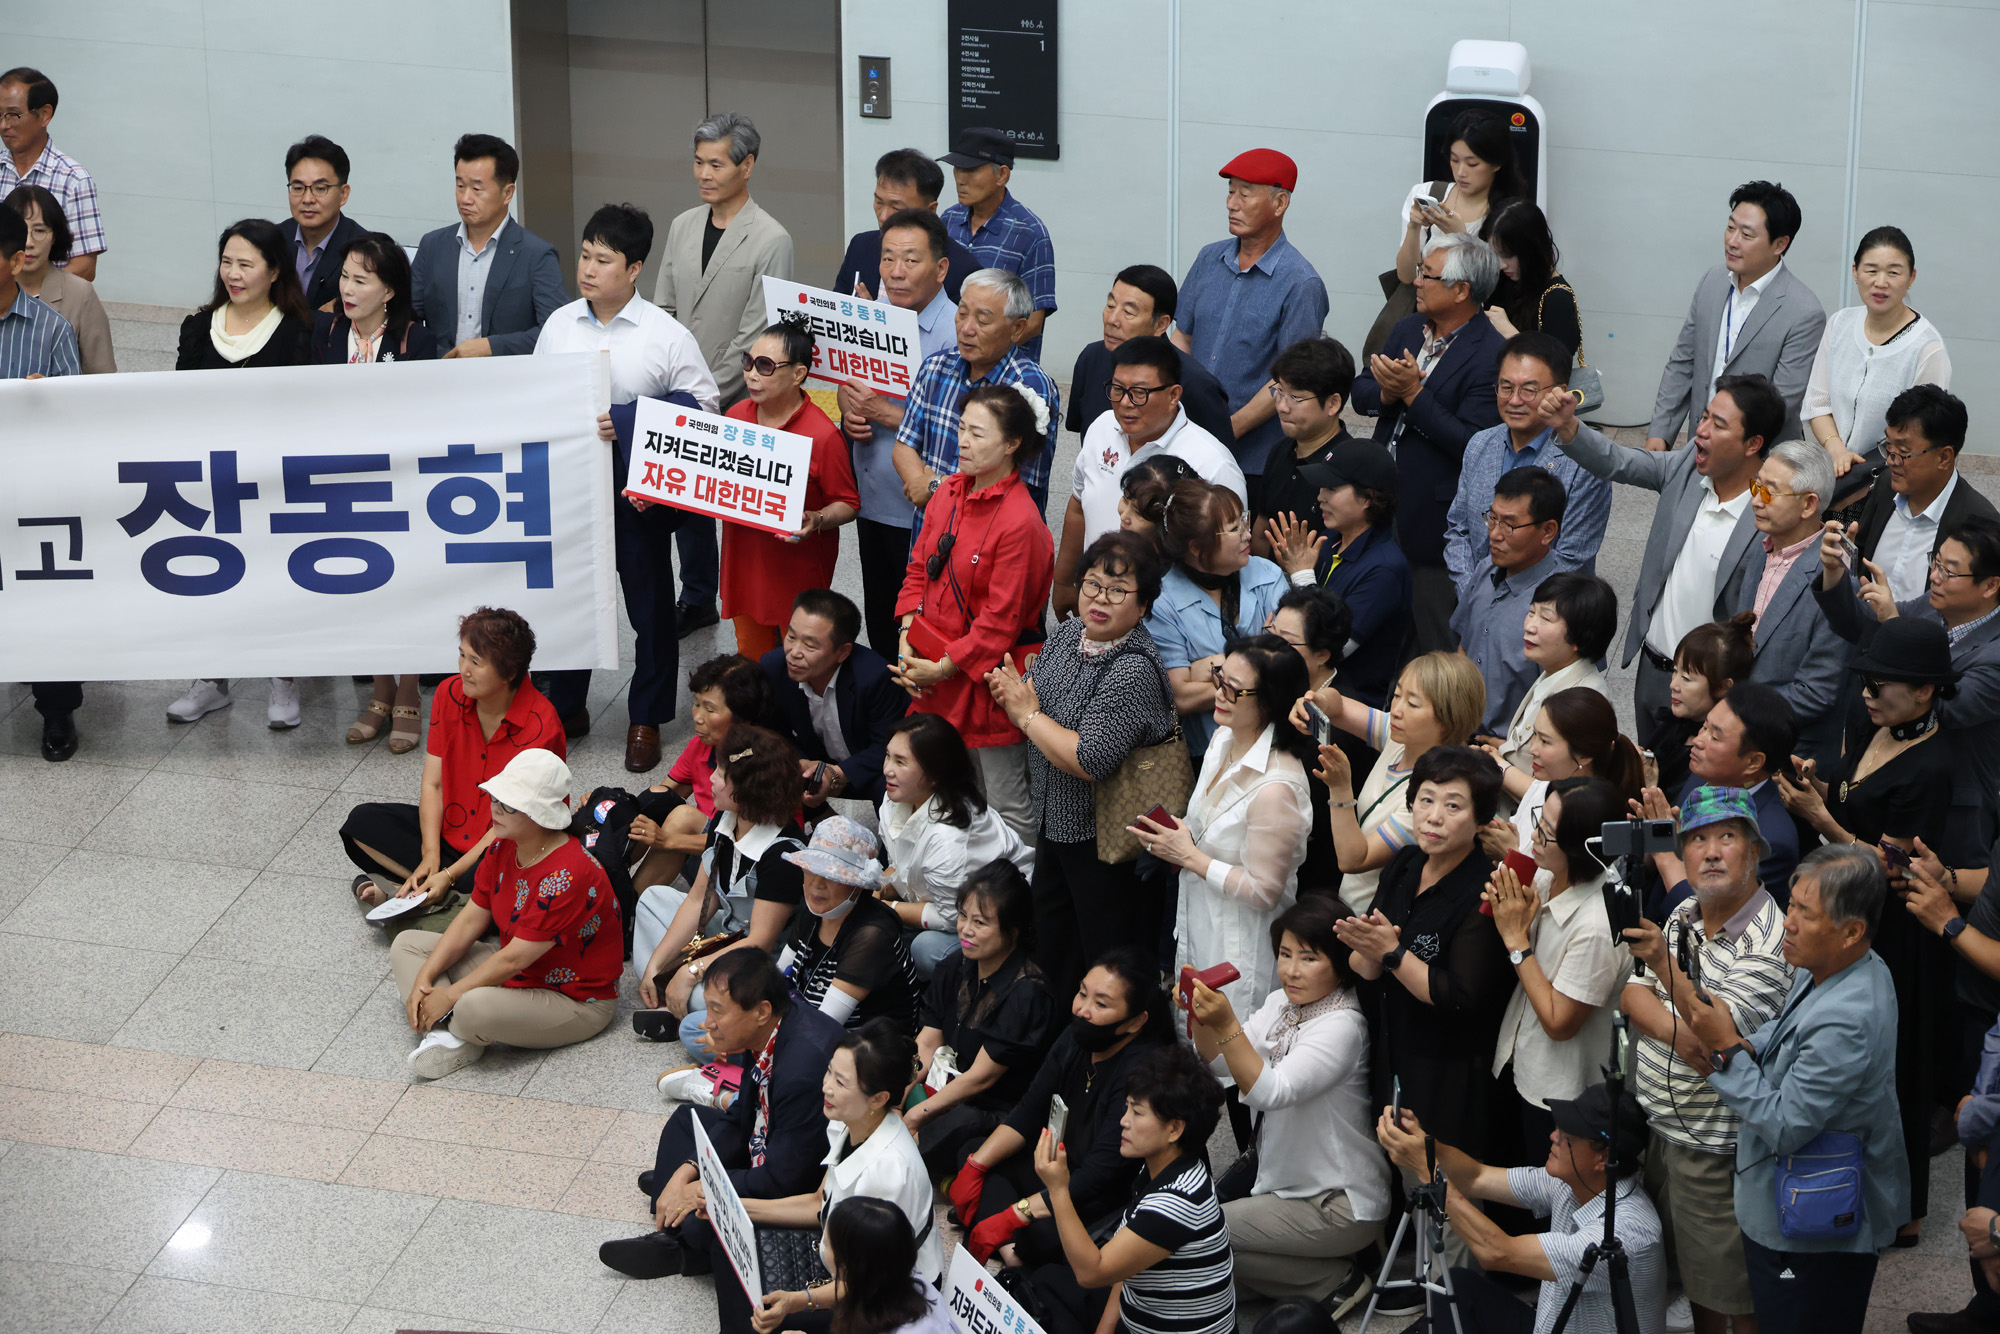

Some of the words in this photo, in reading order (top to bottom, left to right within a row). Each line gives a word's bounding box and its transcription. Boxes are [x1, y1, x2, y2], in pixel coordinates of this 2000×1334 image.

[1040, 40, 1045, 52] 1
[809, 296, 837, 311] 국민의힘
[828, 347, 911, 391] 대한민국
[688, 418, 719, 435] 국민의힘
[644, 430, 793, 486] 지켜드리겠습니다
[641, 461, 687, 496] 자유
[693, 473, 787, 522] 대한민국
[0, 516, 94, 591] 고
[116, 441, 554, 597] 장동혁
[983, 1286, 1003, 1313] 국민의힘
